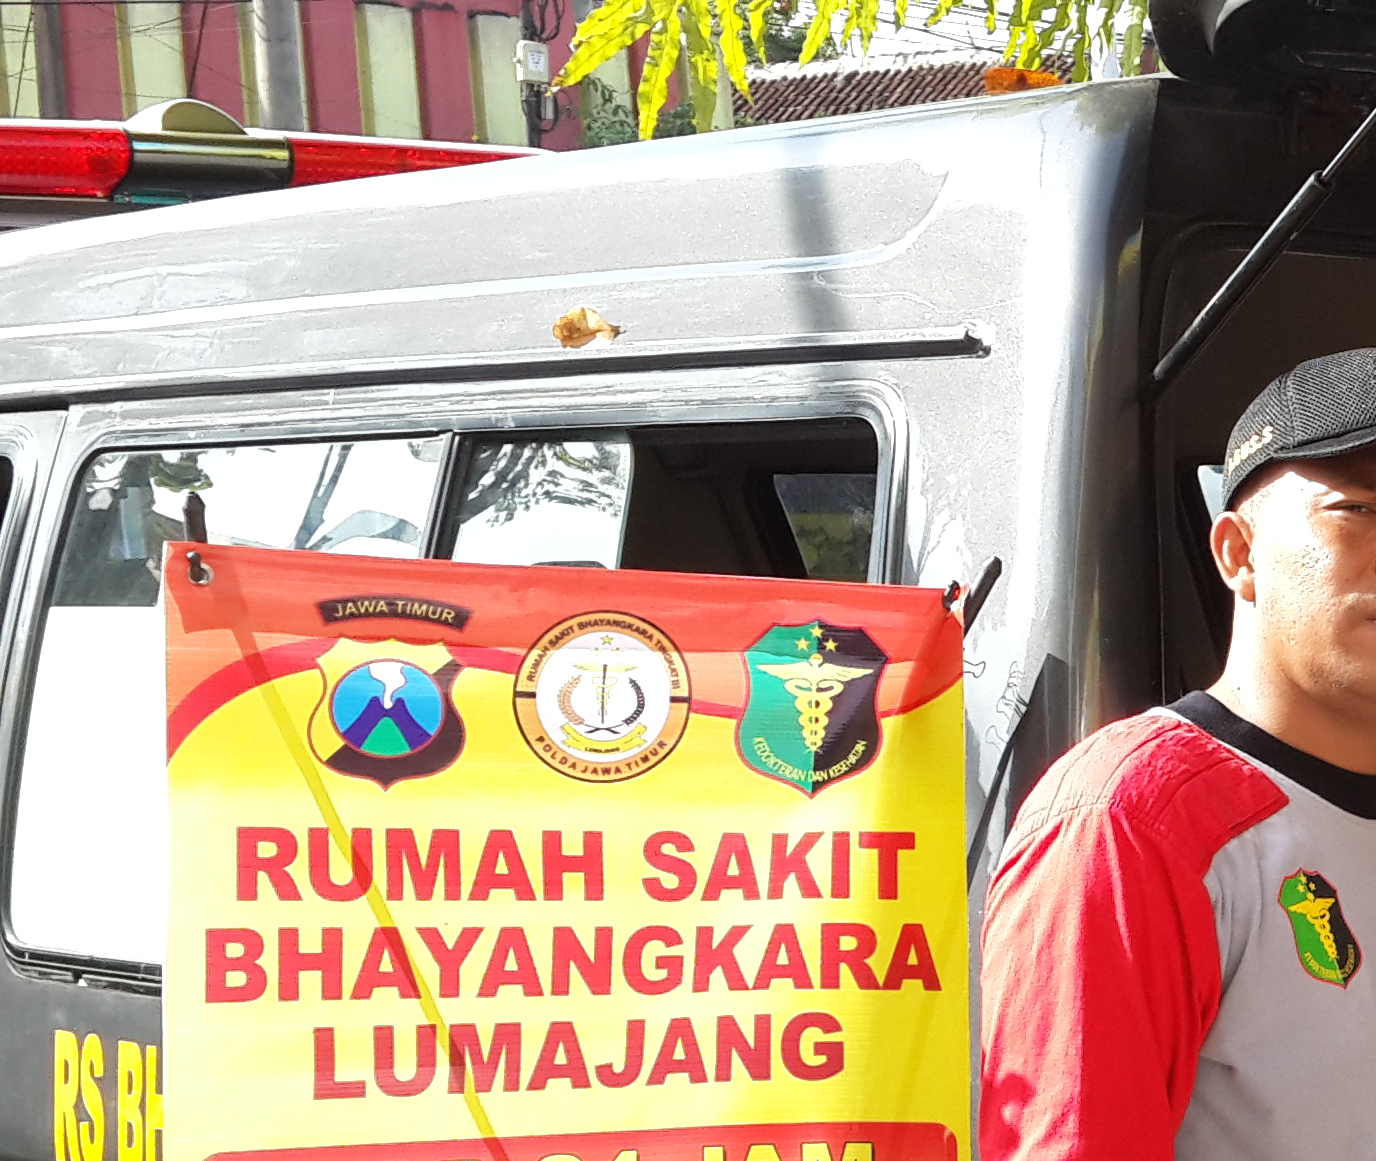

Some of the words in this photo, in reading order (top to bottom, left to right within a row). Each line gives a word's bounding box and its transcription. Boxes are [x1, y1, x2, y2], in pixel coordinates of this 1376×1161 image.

[333, 599, 389, 618] JAWA
[395, 600, 456, 624] TIMUR
[526, 646, 550, 682] RUMAH
[548, 626, 576, 647] SAKIT
[578, 618, 654, 643] BHAYANGKARA
[535, 735, 578, 771] POLDA
[580, 766, 623, 777] JAWA
[626, 740, 668, 771] TIMUR
[807, 770, 829, 783] DAN
[235, 825, 604, 902] RUMAH
[641, 830, 915, 902] SAKIT
[204, 922, 942, 1004] BHAYANGKARA
[313, 1012, 845, 1101] LUMAJANG
